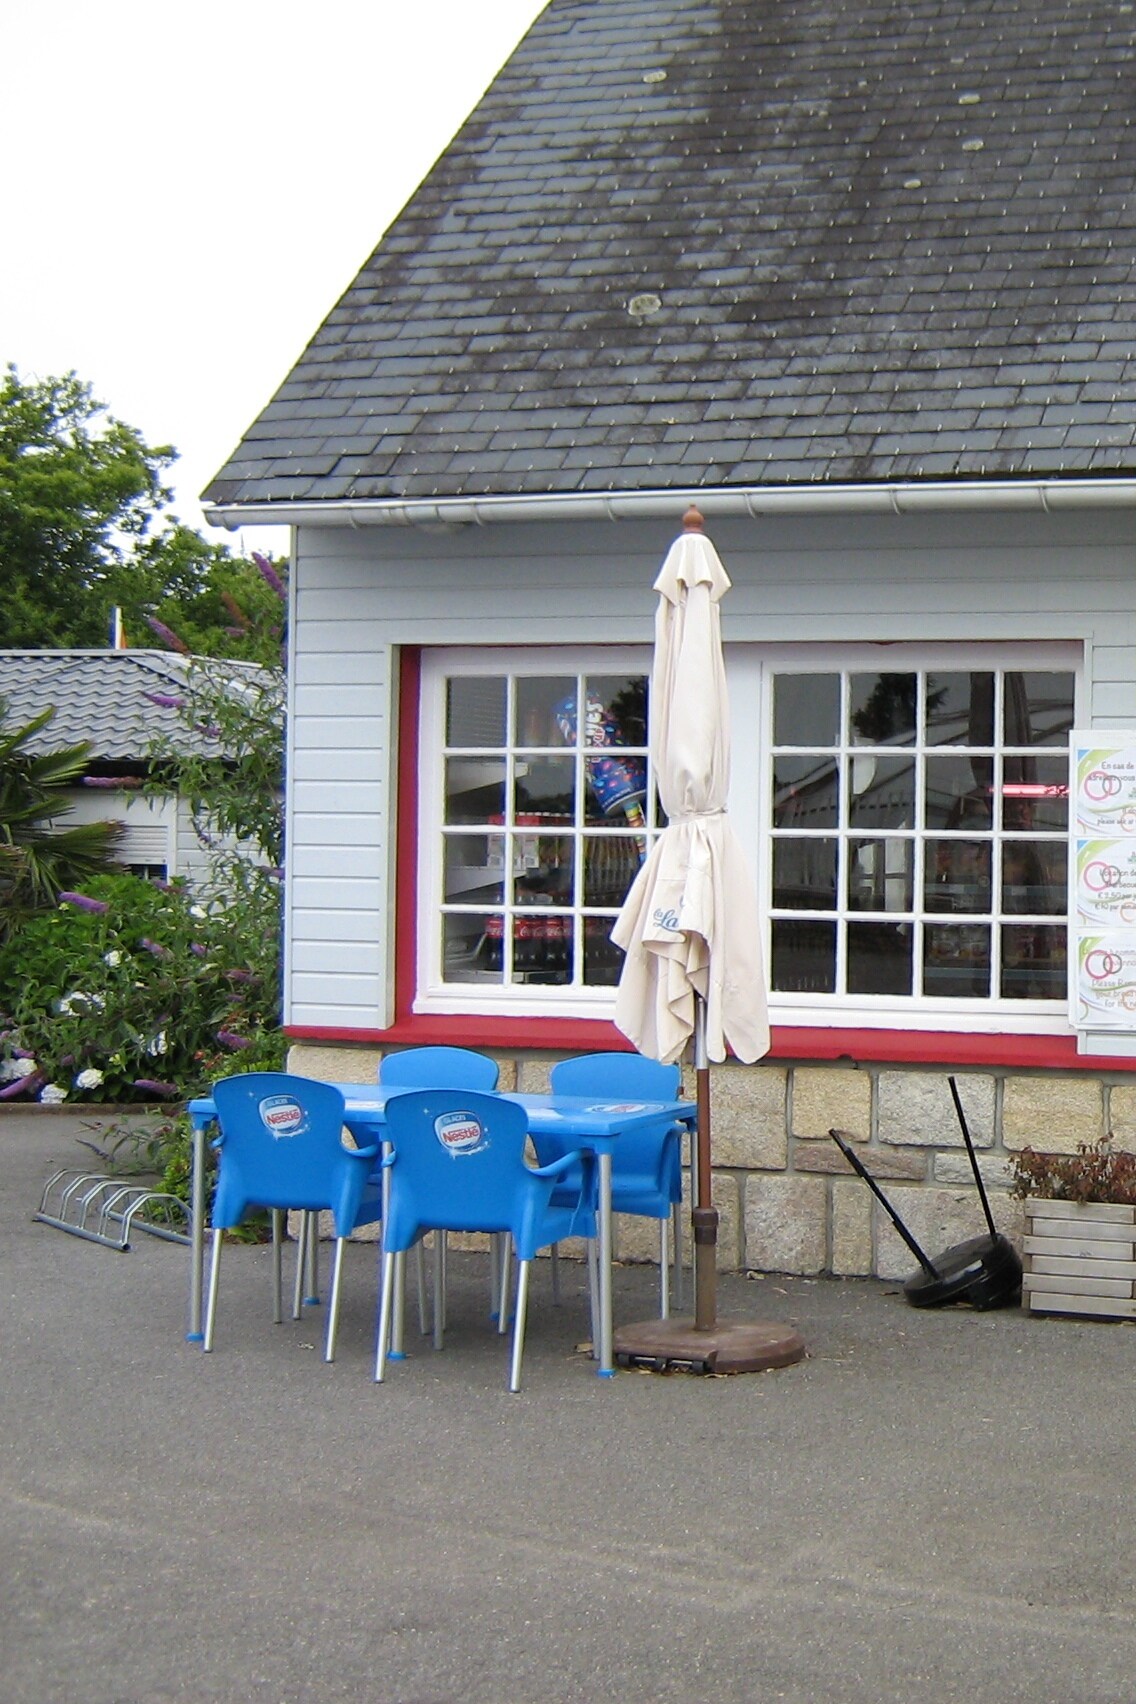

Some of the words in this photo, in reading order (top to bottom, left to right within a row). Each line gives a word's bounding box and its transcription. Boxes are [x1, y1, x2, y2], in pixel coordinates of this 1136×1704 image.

[1101, 761, 1112, 770] En
[1126, 761, 1135, 770] de
[266, 1108, 301, 1125] Nestlé
[442, 1126, 480, 1143] Nestlé
